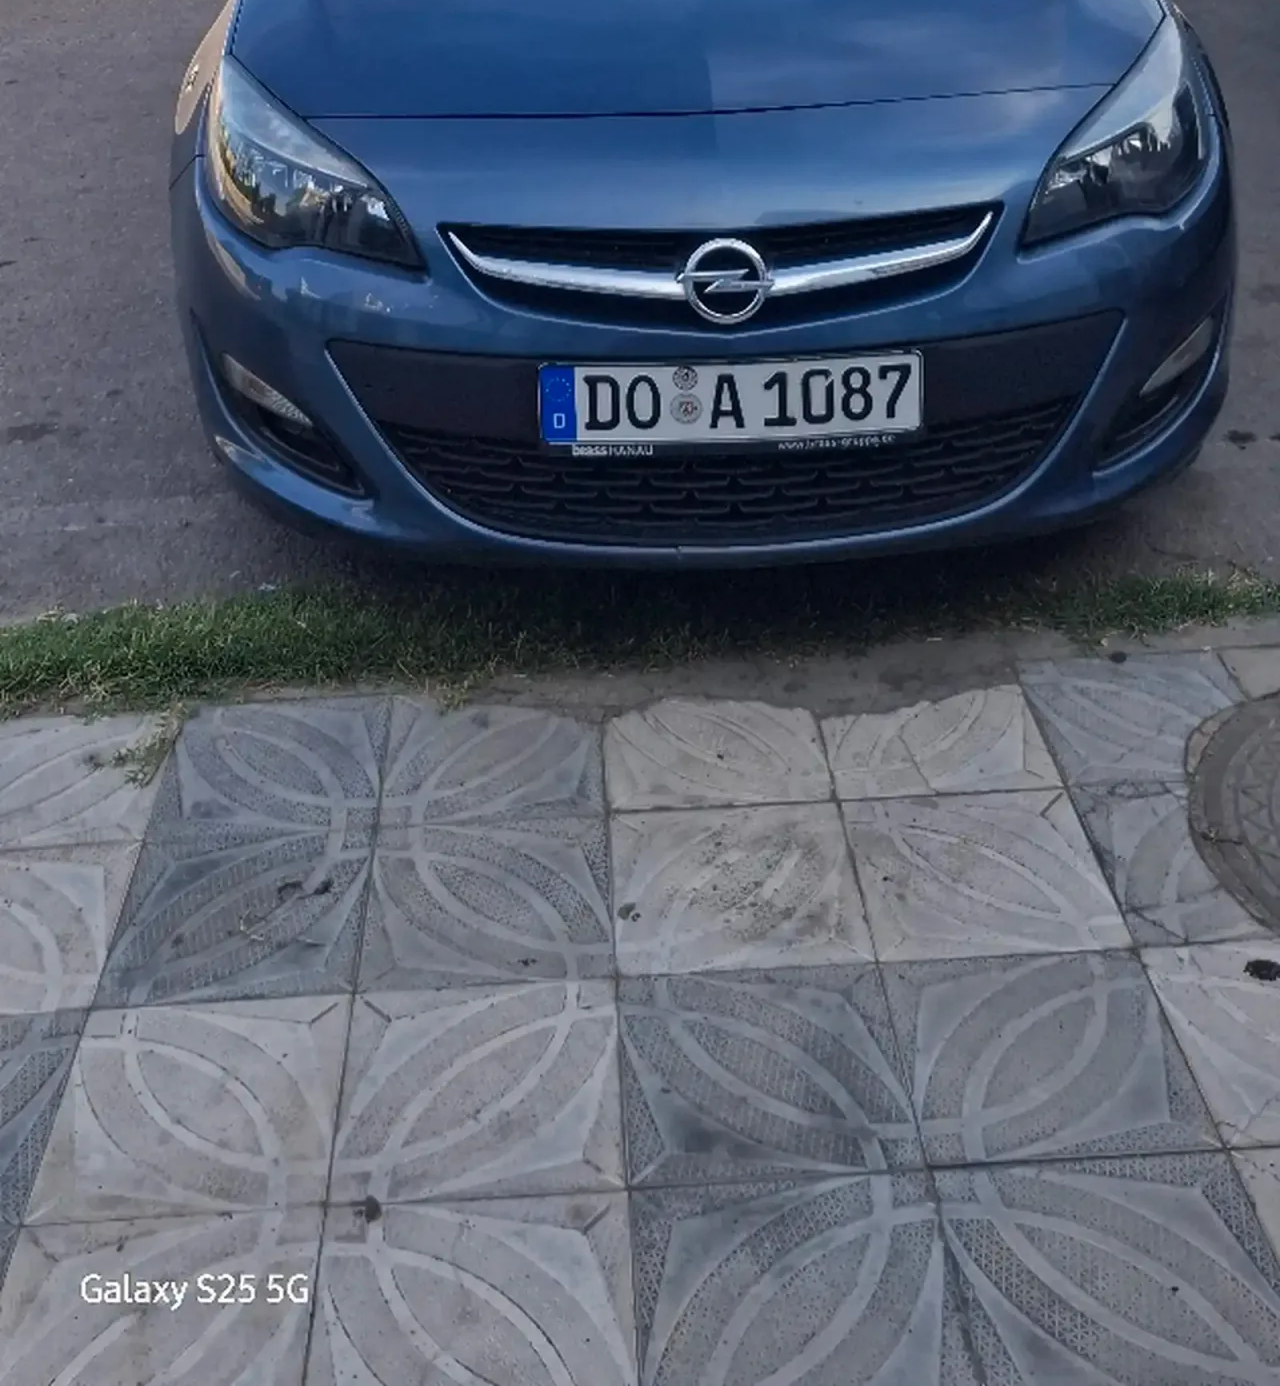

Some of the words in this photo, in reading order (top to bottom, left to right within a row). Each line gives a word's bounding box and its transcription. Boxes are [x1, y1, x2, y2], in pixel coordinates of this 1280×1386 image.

[583, 374, 661, 431] DO
[709, 373, 745, 429] A
[763, 364, 912, 428] 1087
[553, 414, 566, 430] D
